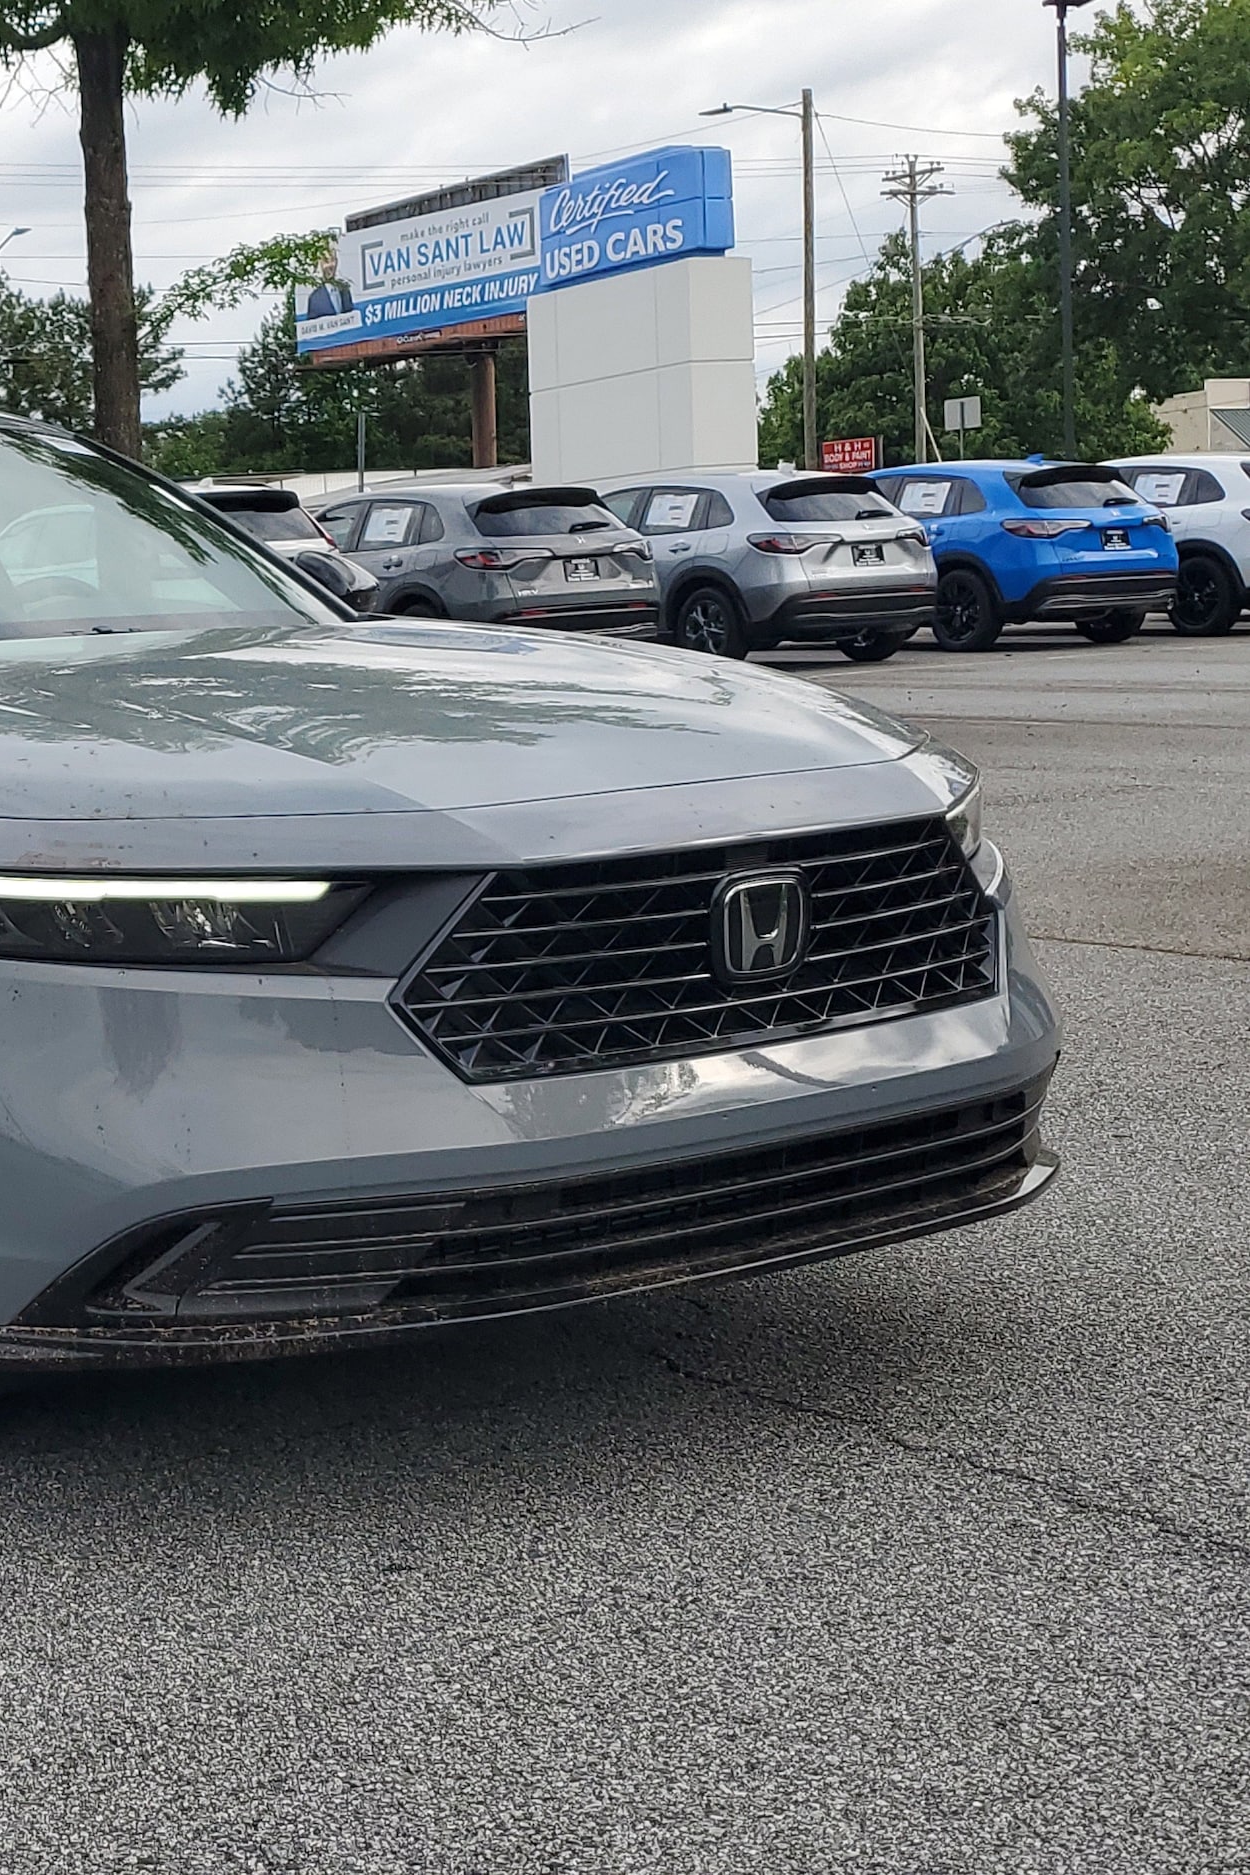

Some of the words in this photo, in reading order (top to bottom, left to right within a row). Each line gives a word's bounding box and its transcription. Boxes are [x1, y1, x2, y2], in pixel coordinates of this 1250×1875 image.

[400, 228, 425, 242] make
[428, 225, 443, 237] the
[445, 217, 470, 234] right
[472, 212, 489, 227] call
[550, 170, 675, 235] Certified
[369, 246, 411, 277] VAN
[417, 233, 473, 266] SANT
[479, 221, 525, 254] LAW
[390, 268, 432, 290] personal
[433, 262, 462, 280] injury
[463, 255, 503, 273] lawyers
[545, 239, 600, 279] USED
[606, 218, 684, 262] CARS
[364, 303, 383, 326] $3
[384, 292, 441, 322] MILLION
[443, 284, 483, 310] NECK
[484, 272, 539, 301] INJURY
[834, 443, 842, 452] H
[854, 441, 861, 450] H
